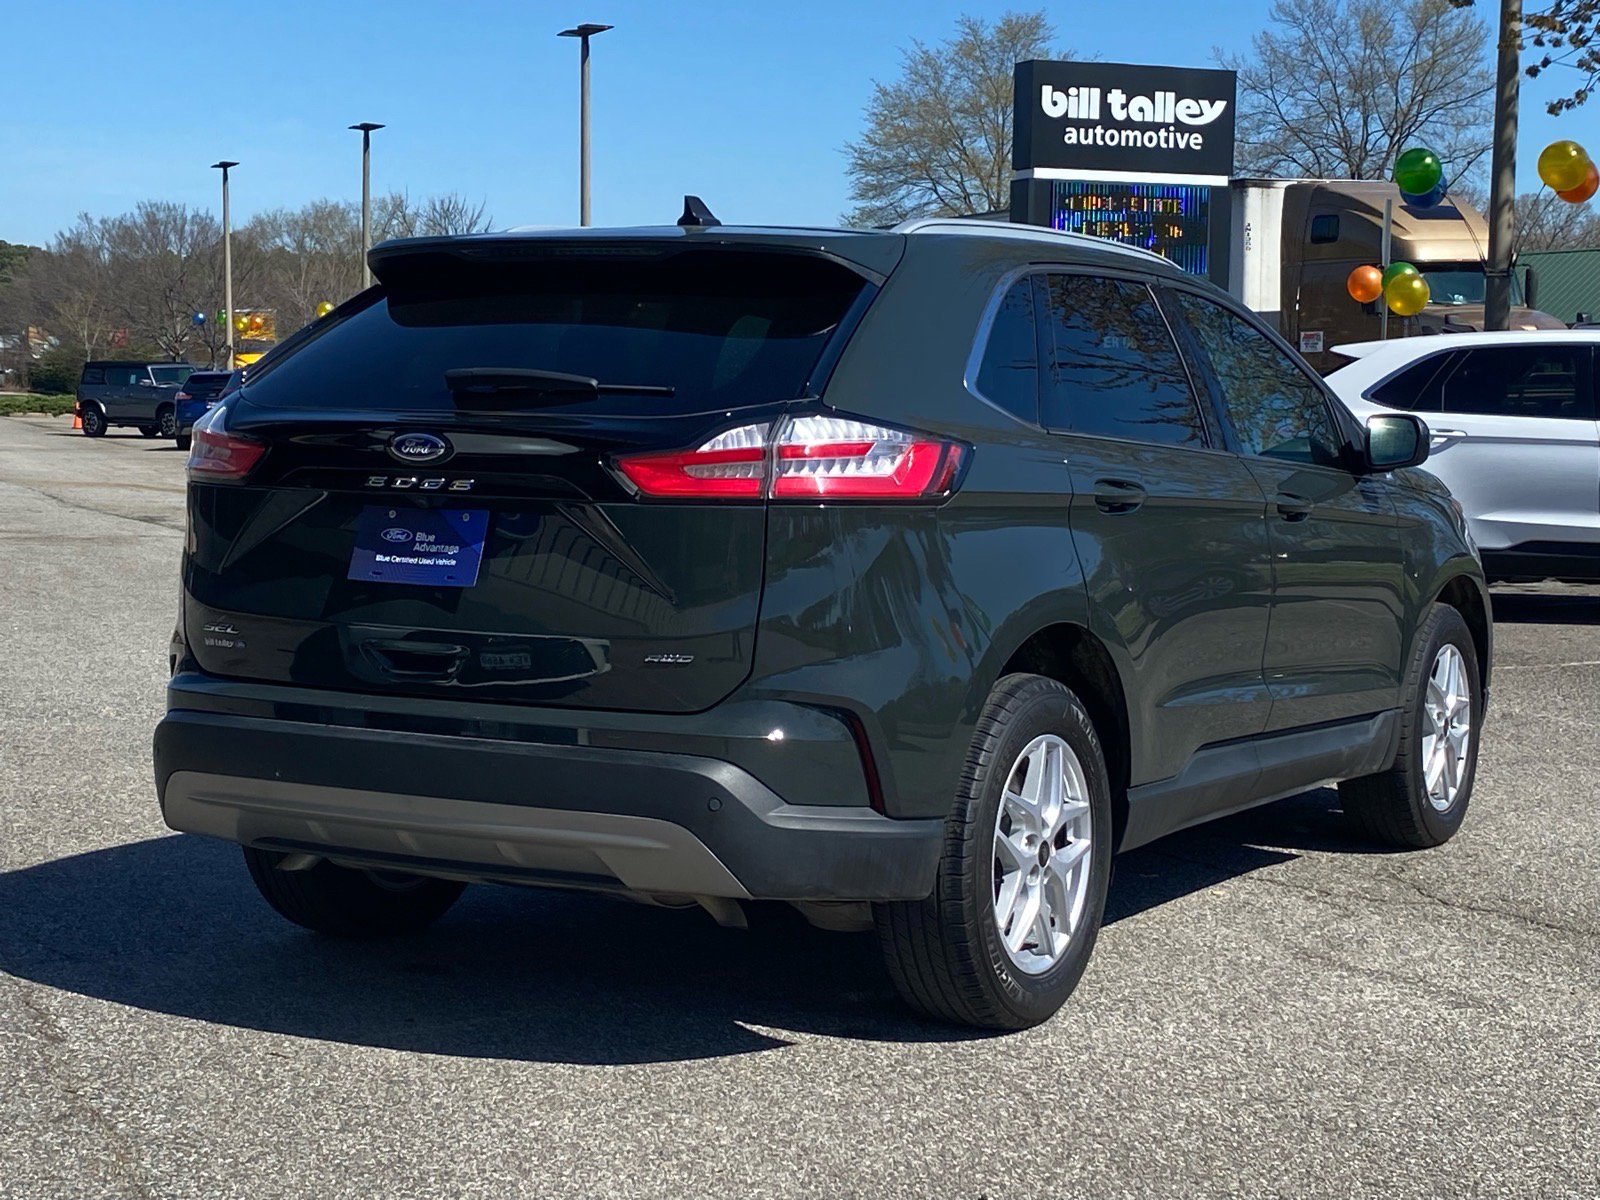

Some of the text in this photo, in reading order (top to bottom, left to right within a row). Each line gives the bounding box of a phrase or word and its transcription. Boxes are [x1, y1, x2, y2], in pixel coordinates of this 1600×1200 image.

[1041, 85, 1227, 125] bill talley
[1064, 124, 1203, 150] automotive
[401, 439, 432, 454] Ford
[364, 476, 475, 490] EDGE
[415, 532, 436, 542] Blue
[413, 543, 460, 555] Advantage
[375, 554, 457, 566] Blue Certified Used Vehicle
[203, 624, 240, 635] SEL
[644, 654, 694, 663] AWD
